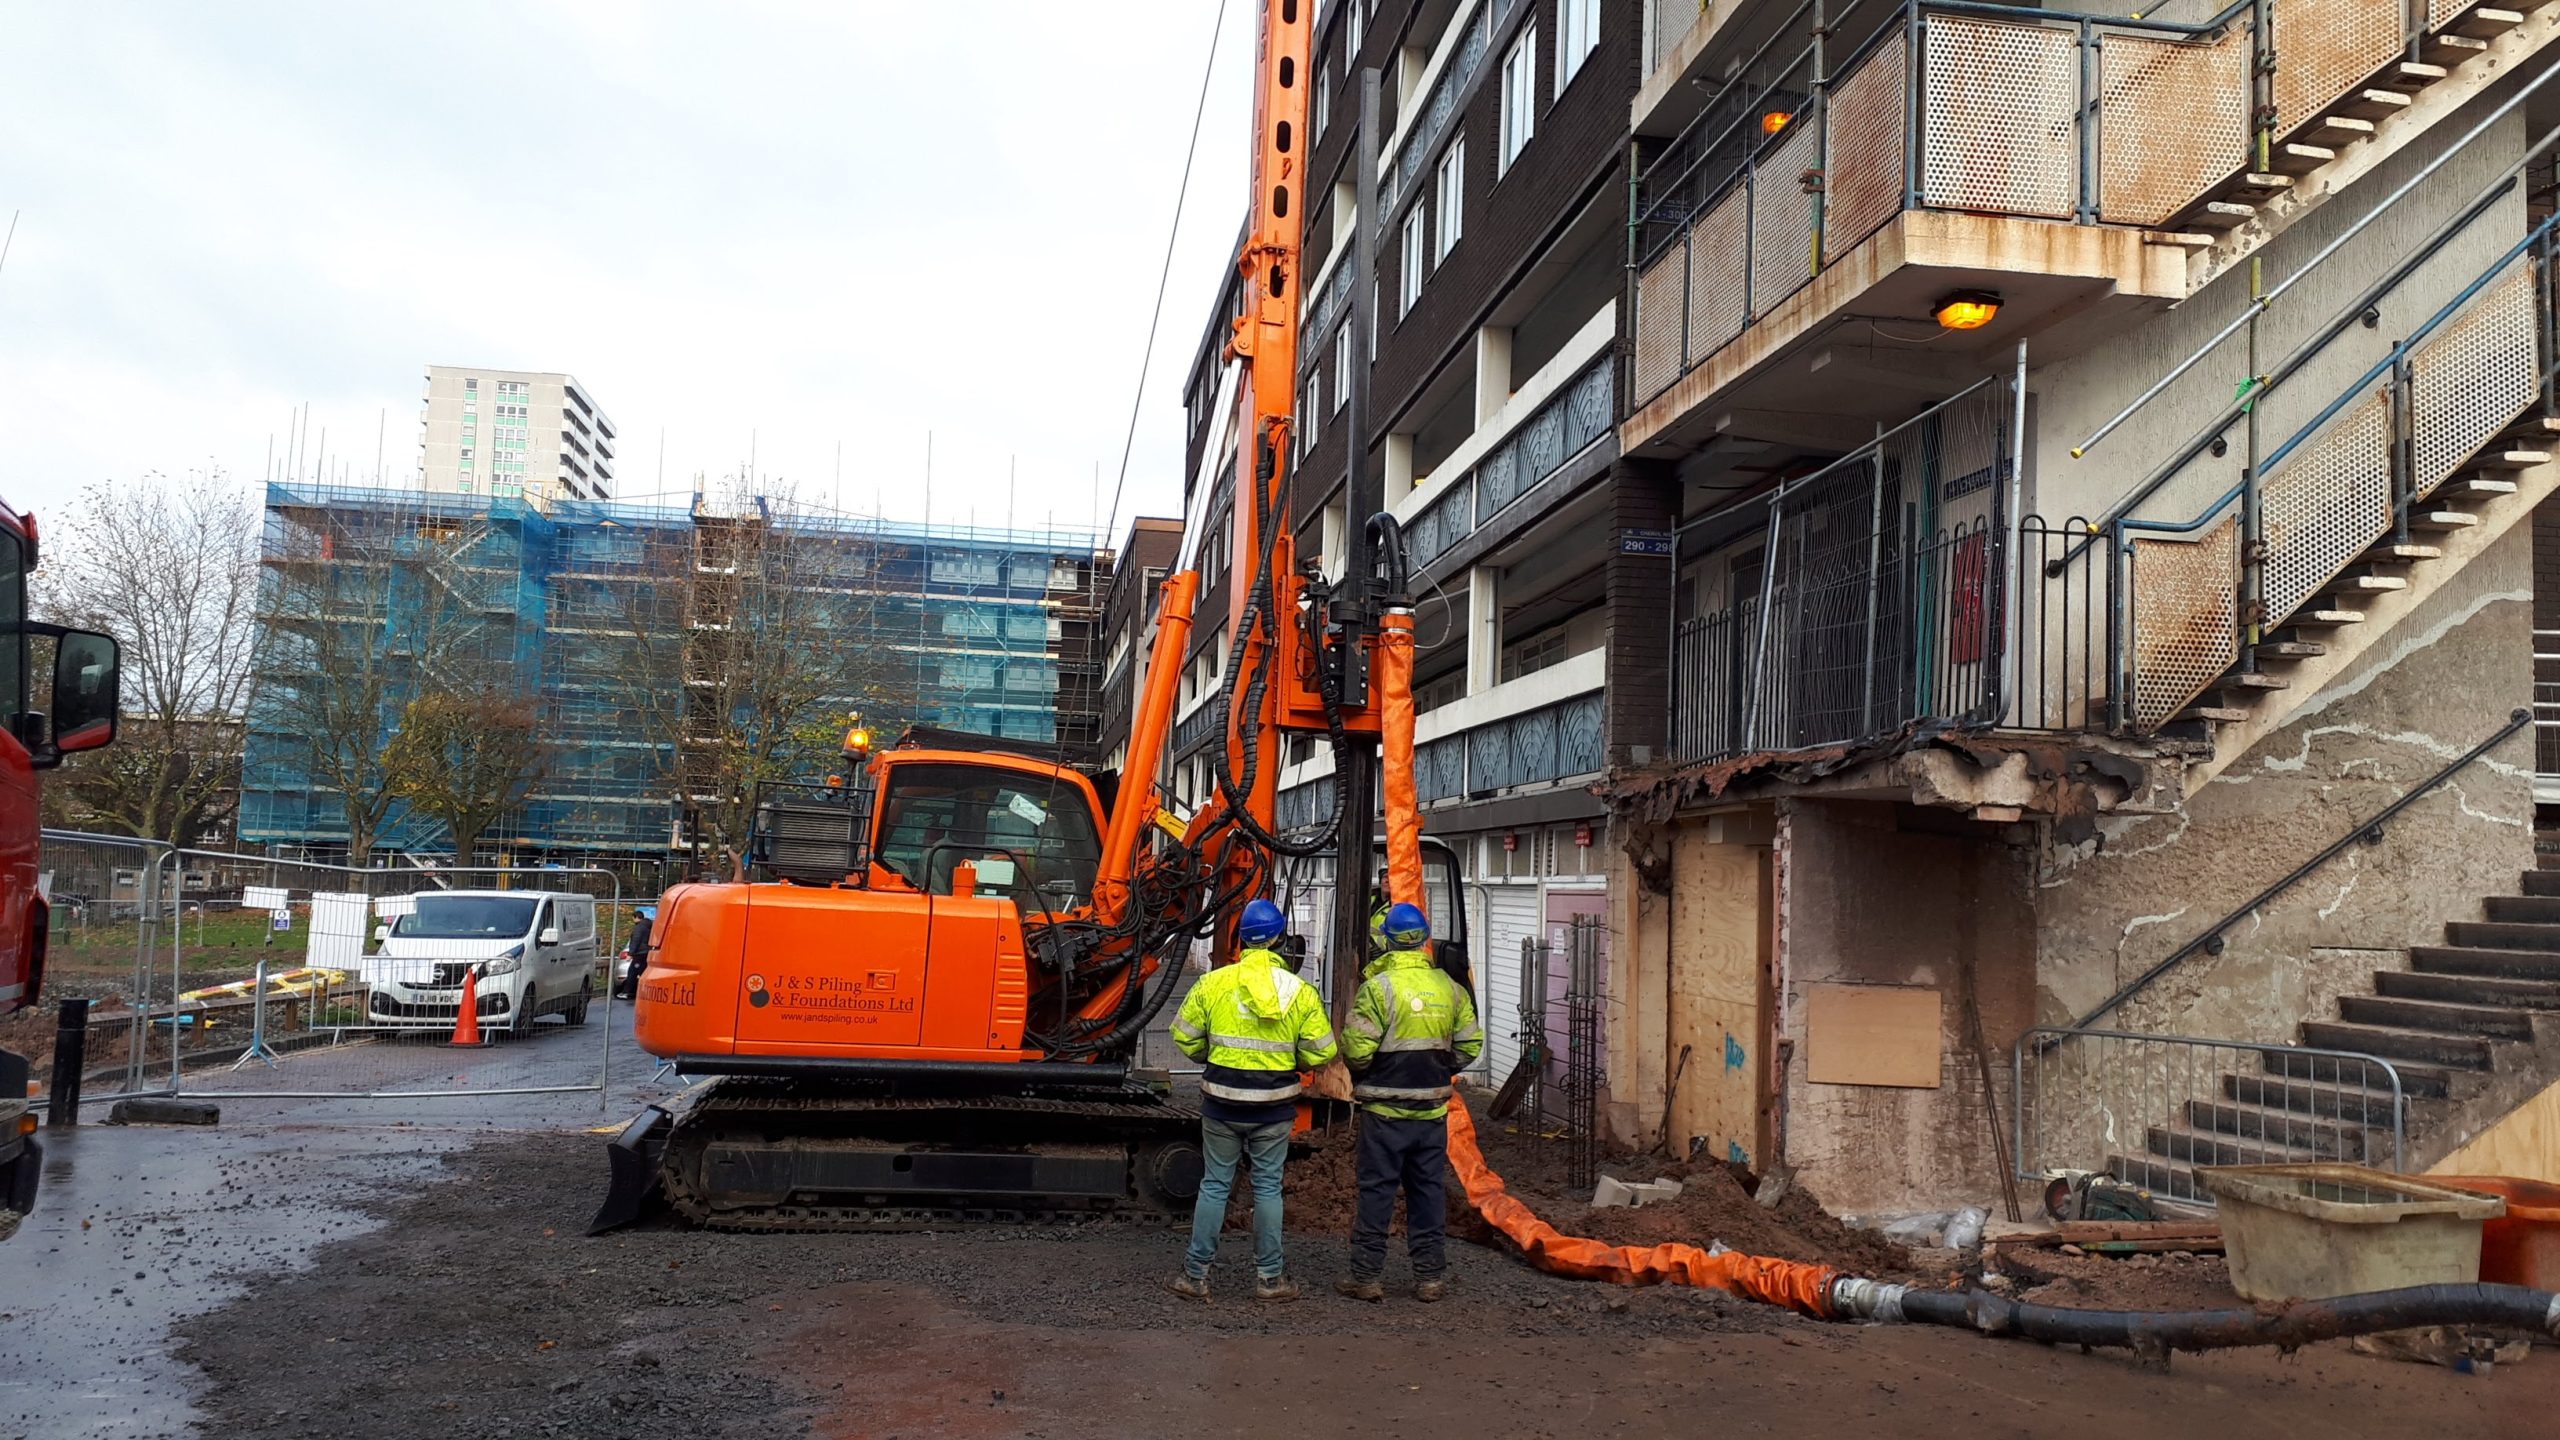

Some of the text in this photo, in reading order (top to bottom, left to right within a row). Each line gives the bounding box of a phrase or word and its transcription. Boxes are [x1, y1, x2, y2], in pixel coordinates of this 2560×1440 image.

[1624, 540, 1645, 551] 290
[672, 982, 696, 1006] Ltd
[774, 975, 863, 994] J & S Piling
[772, 992, 914, 1011] & Foundations Ltd
[780, 1012, 879, 1025] www.jandspiling.co.uk
